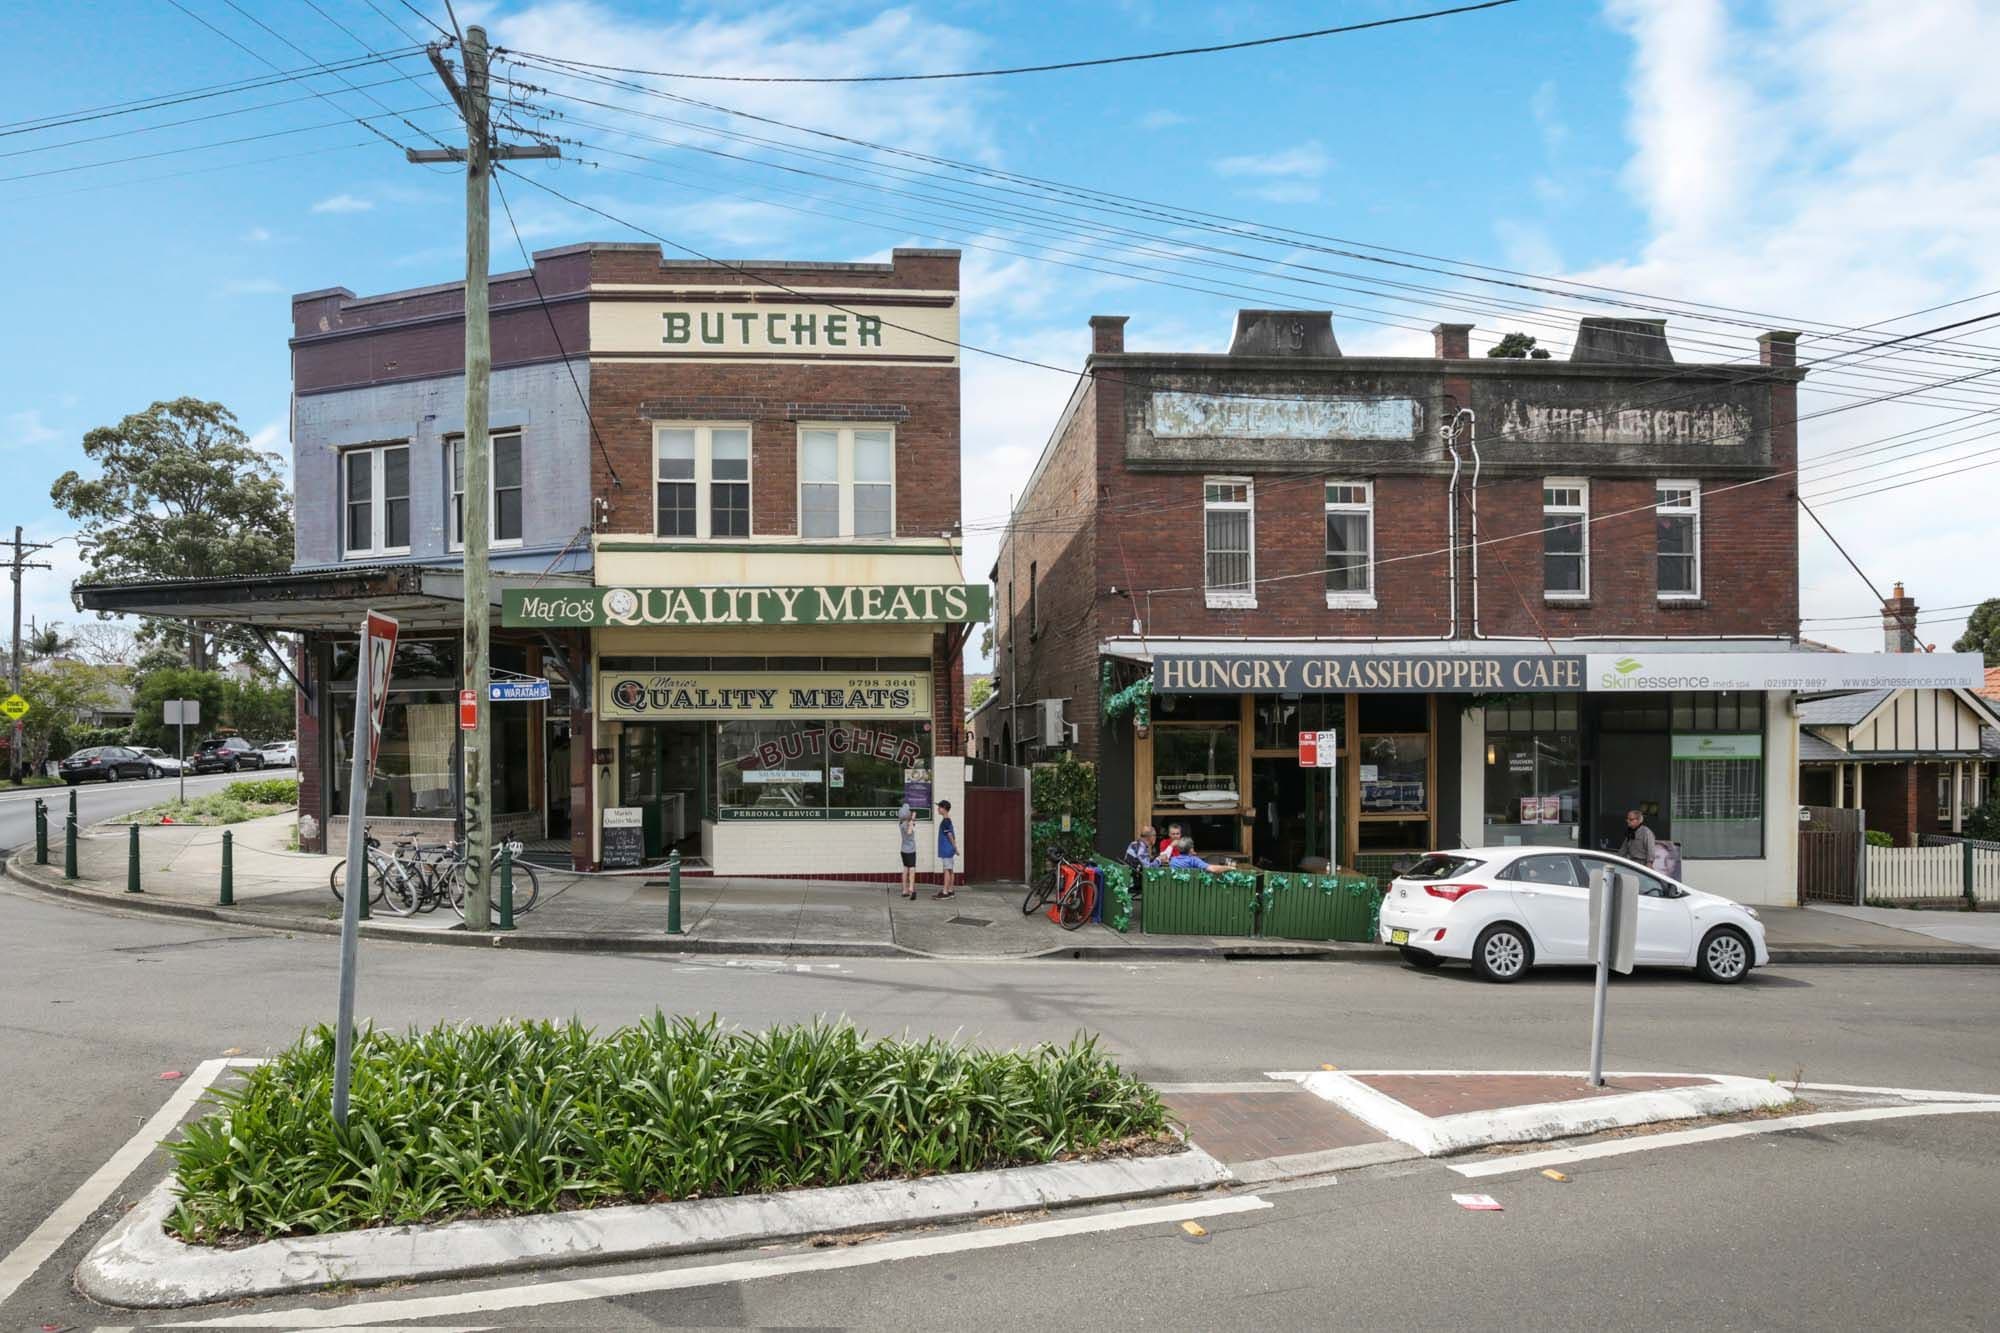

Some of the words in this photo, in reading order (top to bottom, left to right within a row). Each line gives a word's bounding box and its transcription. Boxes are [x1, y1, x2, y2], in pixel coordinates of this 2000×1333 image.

[662, 311, 882, 347] BUTCHER
[520, 596, 594, 623] Mario's
[602, 587, 803, 626] QUALITY
[813, 585, 969, 622] MEATS
[649, 676, 697, 688] Mario's
[848, 679, 880, 687] 9798
[1162, 659, 1292, 689] HUNGRY
[1302, 659, 1503, 689] GRASSHOPPER
[1512, 659, 1581, 688] CAFE
[1601, 673, 1710, 689] Skinessence
[1841, 675, 1972, 688] www.skinessence.com.au
[503, 686, 539, 698] WARATAH
[540, 685, 548, 697] ST
[611, 679, 778, 713] QUALITY
[789, 686, 911, 711] MEATS
[757, 727, 921, 769] BUTCHER
